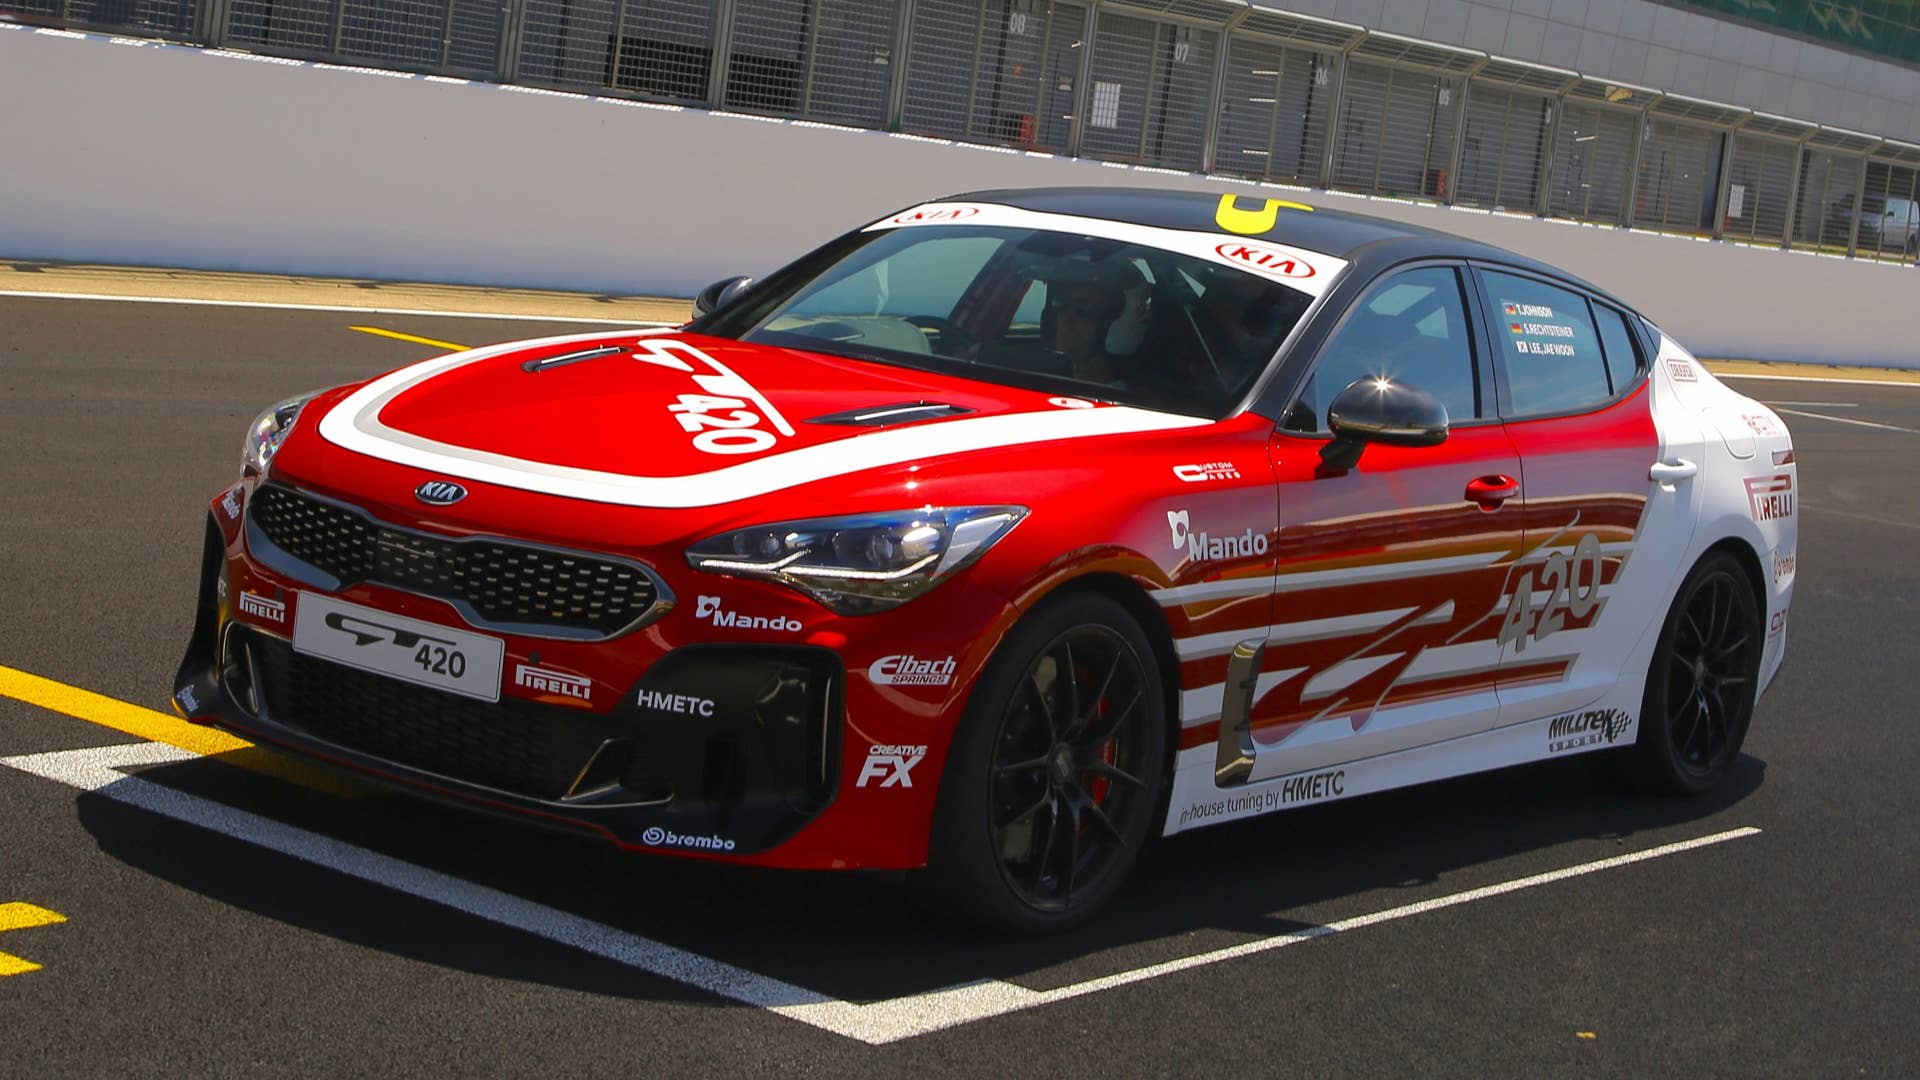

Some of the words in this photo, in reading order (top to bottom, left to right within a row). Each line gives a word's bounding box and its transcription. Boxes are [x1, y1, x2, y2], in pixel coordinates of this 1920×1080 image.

[1010, 12, 1026, 34] 08
[1174, 42, 1188, 62] 07
[1219, 246, 1296, 275] KIA
[667, 393, 777, 455] 420
[420, 481, 458, 501] KIA
[1743, 474, 1793, 522] PIRELLI
[1187, 528, 1268, 562] Mando
[239, 590, 285, 623] PIRELLI
[1496, 533, 1602, 655] 420
[712, 610, 803, 632] Mando
[414, 644, 466, 678] 420
[515, 664, 591, 699] PIRELLI
[891, 674, 947, 685] SPRINGS
[637, 689, 715, 717] HMETC
[869, 744, 928, 756] CREATIVE
[1548, 733, 1602, 752] SPORT
[856, 755, 924, 788] FX
[1227, 793, 1264, 813] tuning
[1265, 788, 1280, 809] by
[1282, 771, 1345, 803] HMETC
[665, 831, 735, 851] brembo
